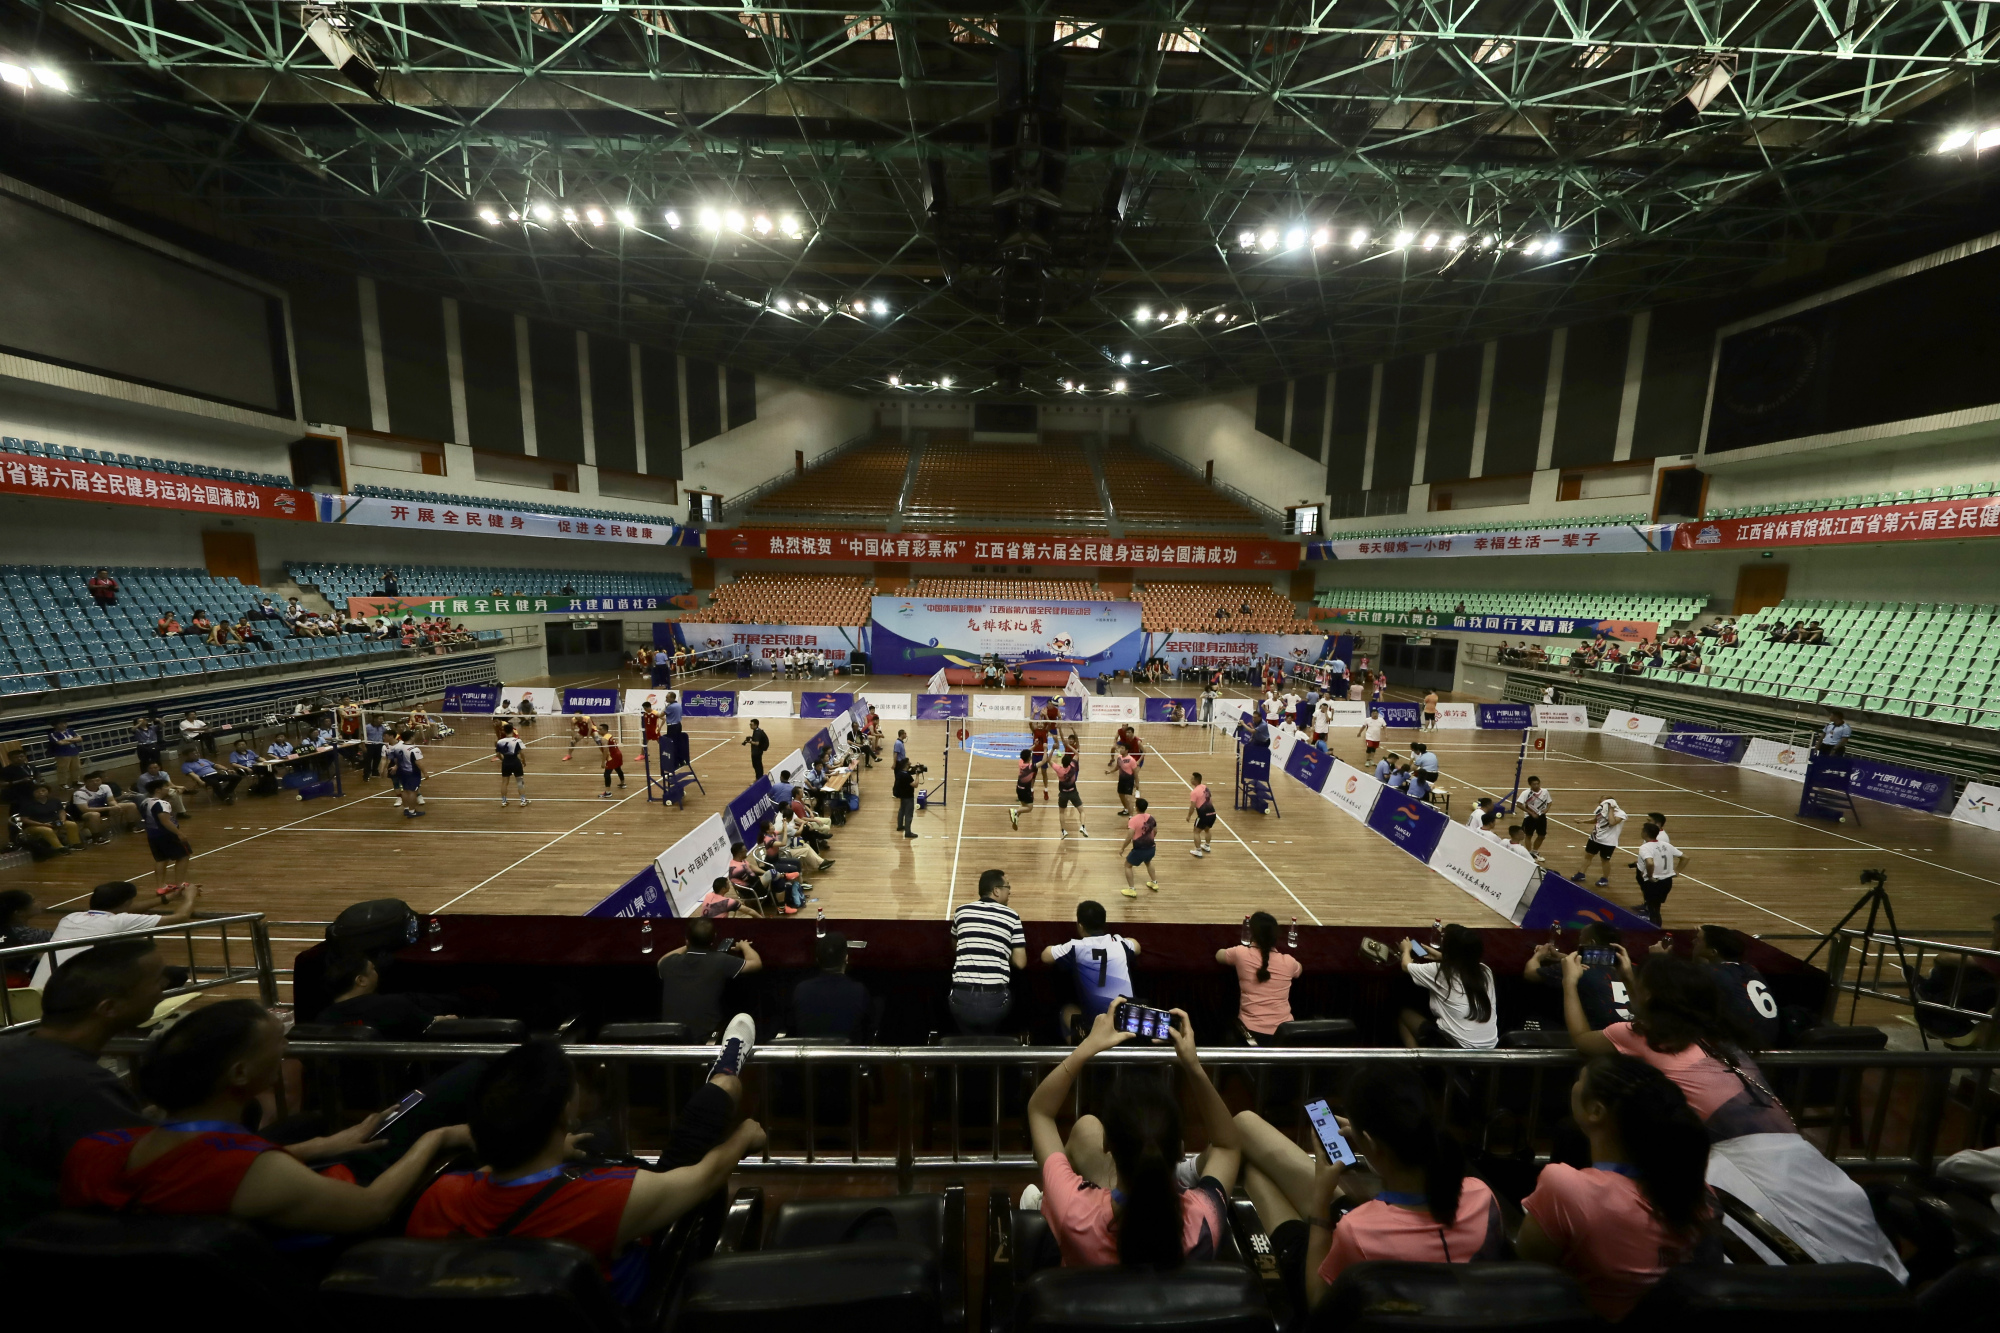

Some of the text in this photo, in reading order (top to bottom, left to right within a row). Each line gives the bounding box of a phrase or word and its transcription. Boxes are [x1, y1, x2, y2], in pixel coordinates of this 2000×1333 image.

[390, 505, 653, 539] 开展全民健身 促进全民健康
[1736, 504, 2000, 541] 江西省体育馆祝江西省第六届全民健
[1359, 532, 1600, 555] 每天锻炼一小时 幸福生活一辈子
[430, 598, 657, 617] 开展全民健身 共建和谐社会
[967, 617, 1043, 634] 气排球比赛
[1347, 610, 1574, 633] 全民健身大舞台 你我同行更精彩
[732, 633, 817, 645] 开展全民健身
[1165, 641, 1259, 653] 全民健身动起来
[688, 836, 727, 875] 中国体育彩票
[1092, 948, 1107, 987] 7
[1746, 980, 1777, 1019] 6
